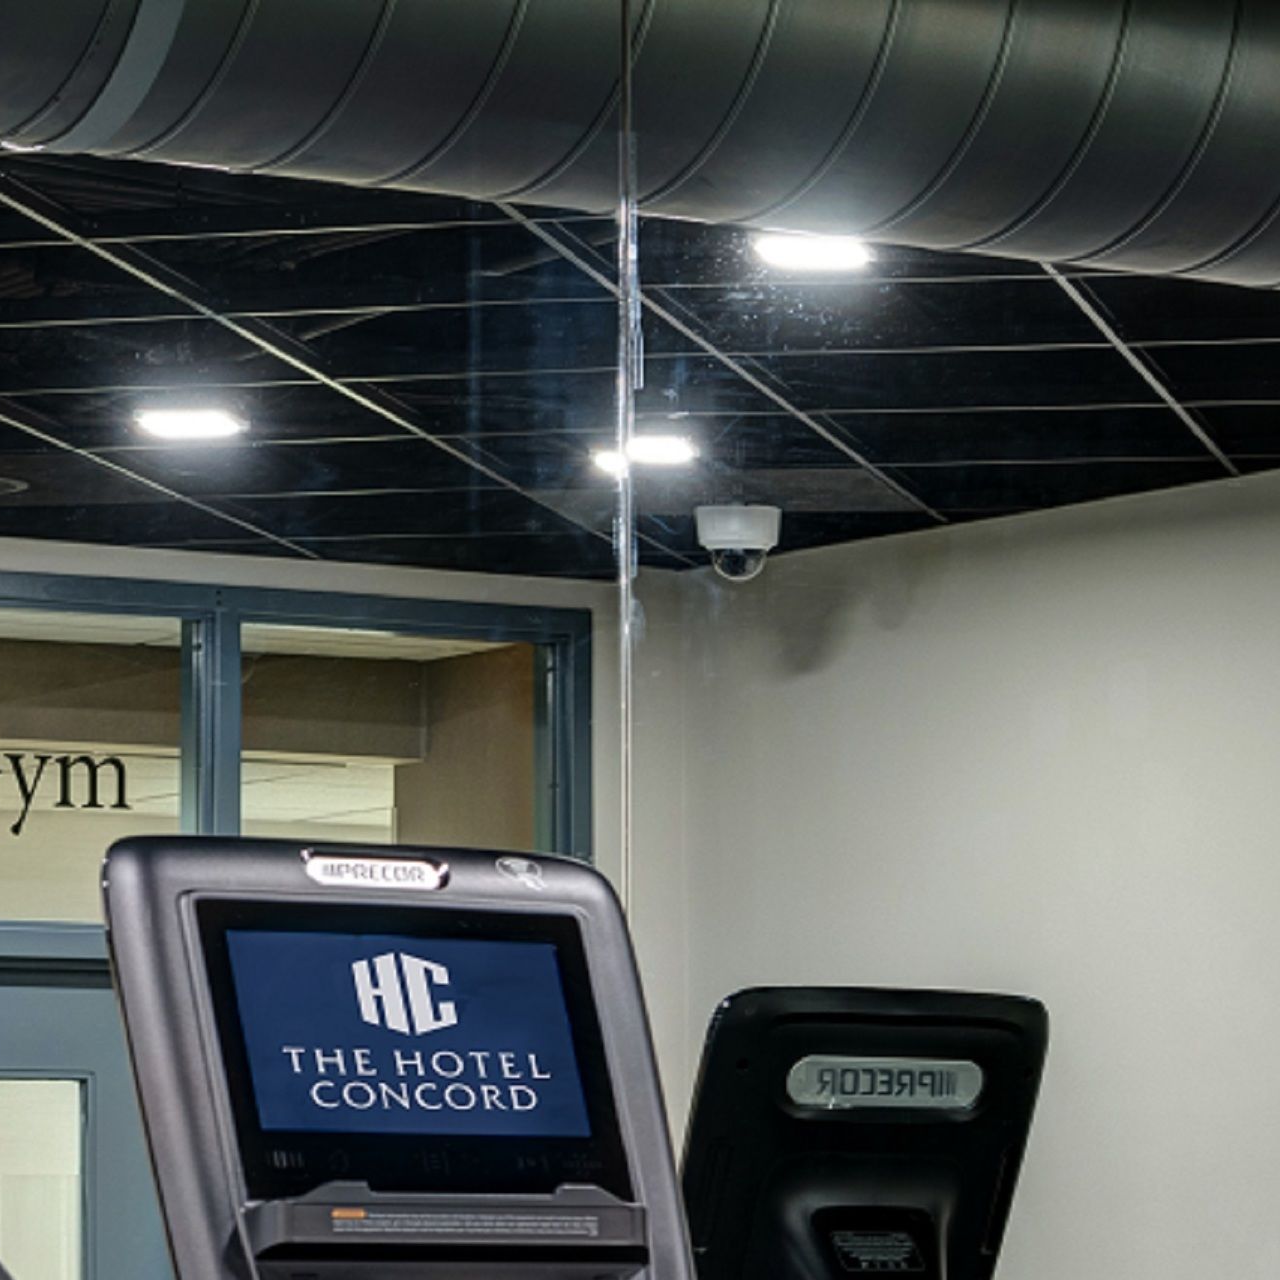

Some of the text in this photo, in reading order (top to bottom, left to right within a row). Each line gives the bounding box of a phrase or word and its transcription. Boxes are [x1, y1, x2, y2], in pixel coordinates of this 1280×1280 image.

[351, 951, 458, 1036] HC
[281, 1045, 552, 1080] THE HOTEL
[308, 1080, 539, 1111] CONCORD
